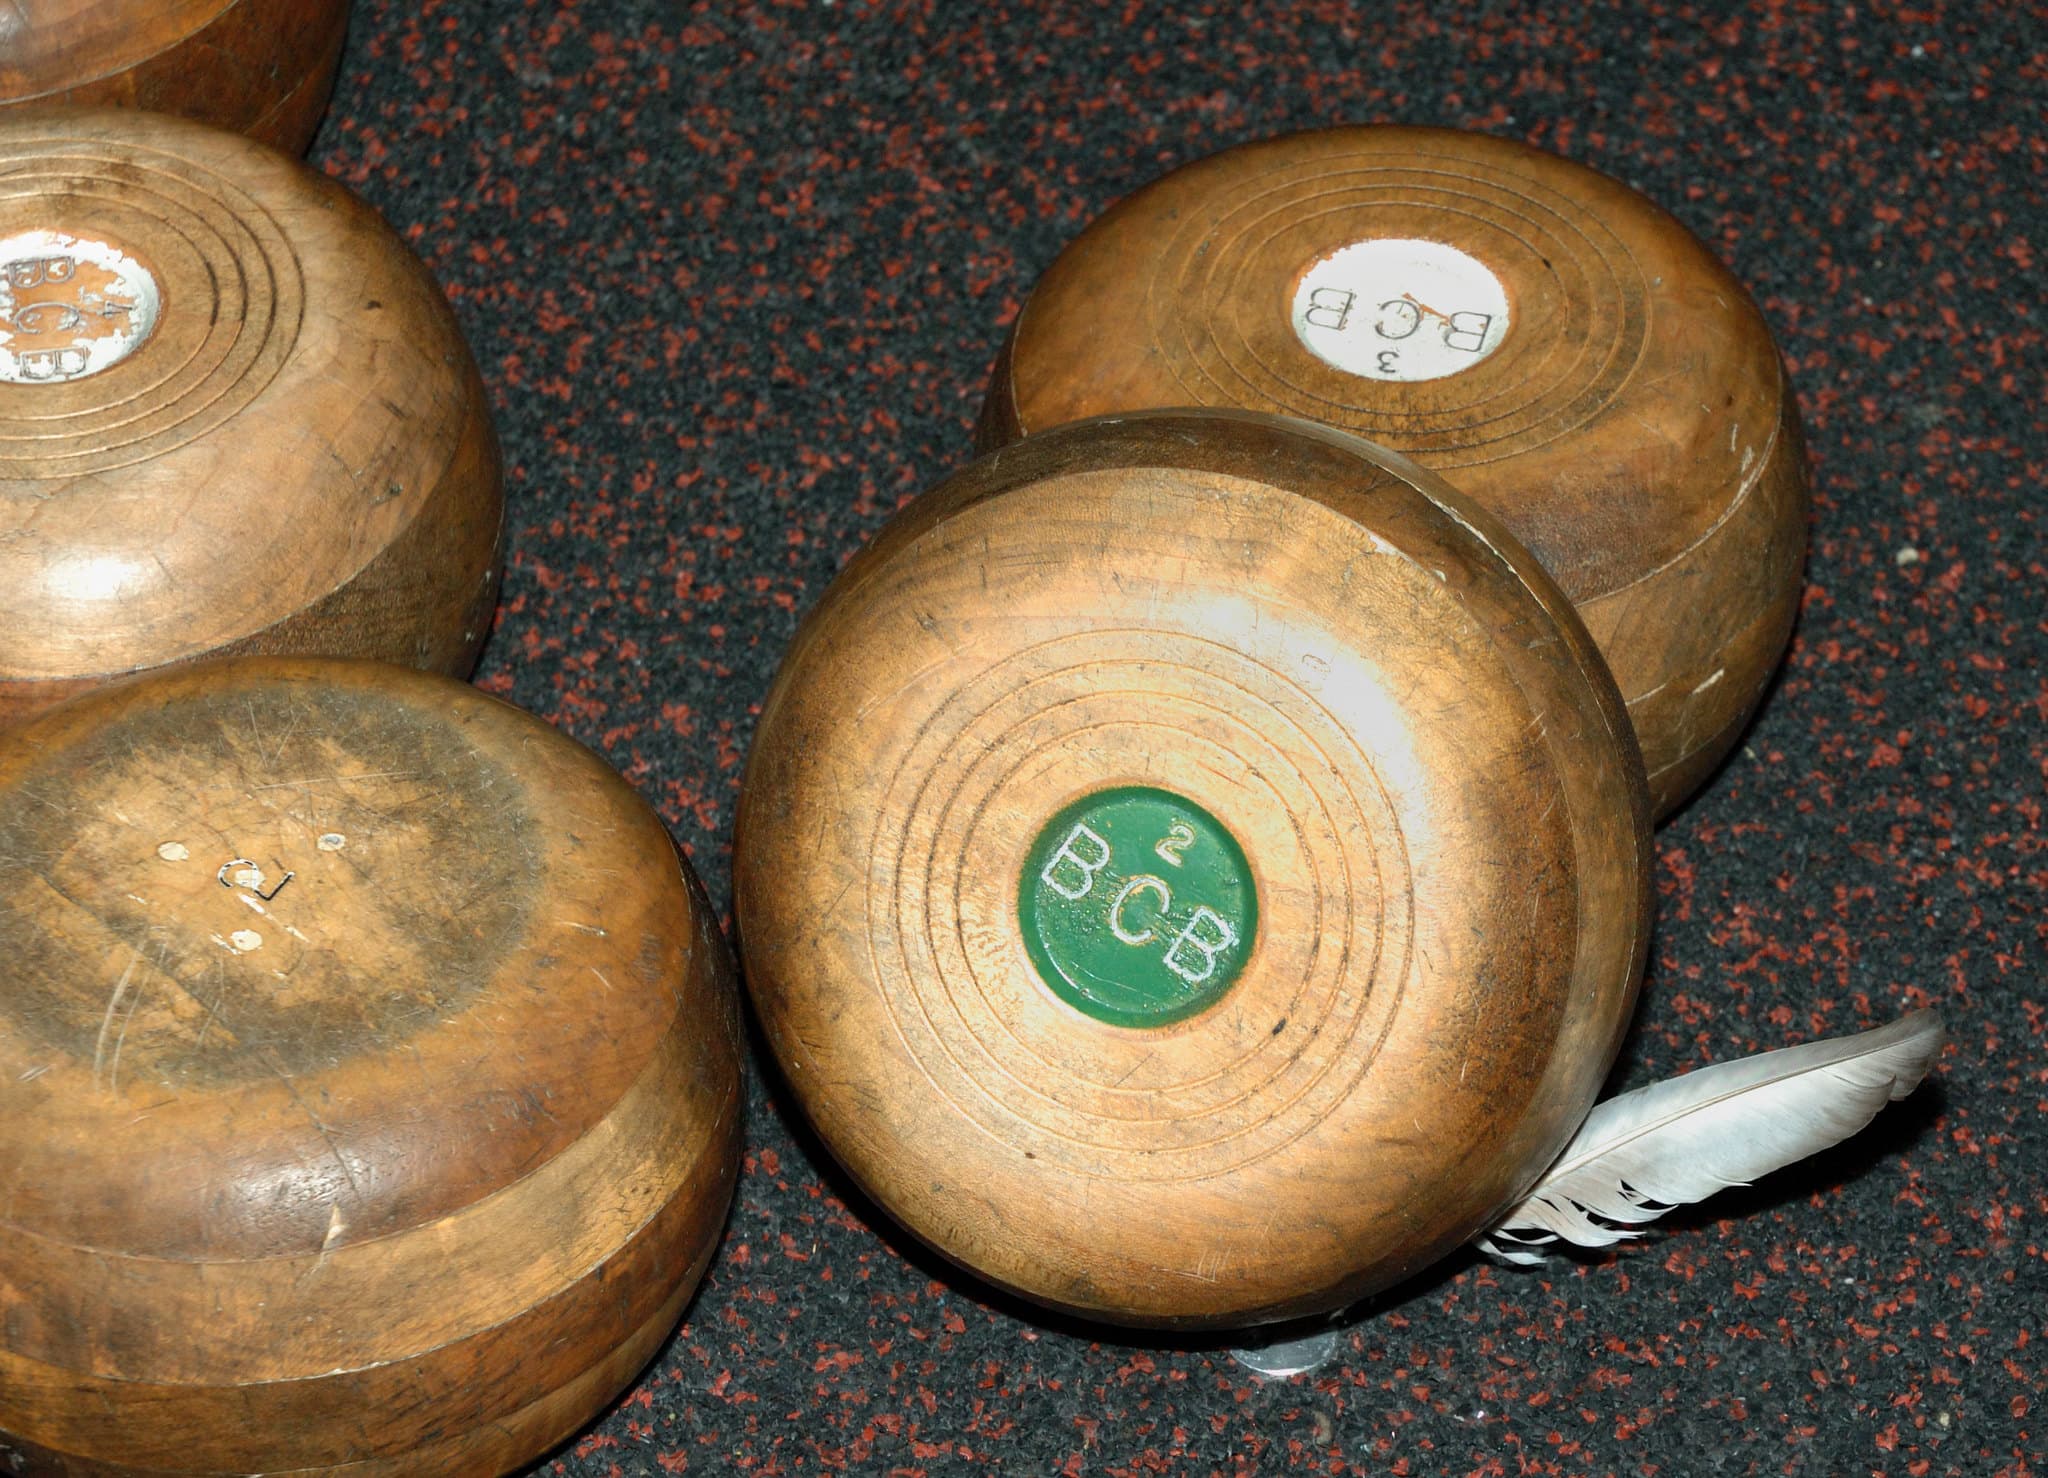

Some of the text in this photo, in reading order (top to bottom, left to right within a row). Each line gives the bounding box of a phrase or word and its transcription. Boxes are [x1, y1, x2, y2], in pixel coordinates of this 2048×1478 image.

[1306, 287, 1491, 352] BCB
[1376, 350, 1399, 373] 3
[1155, 824, 1195, 867] 2
[1042, 823, 1240, 982] BCB
